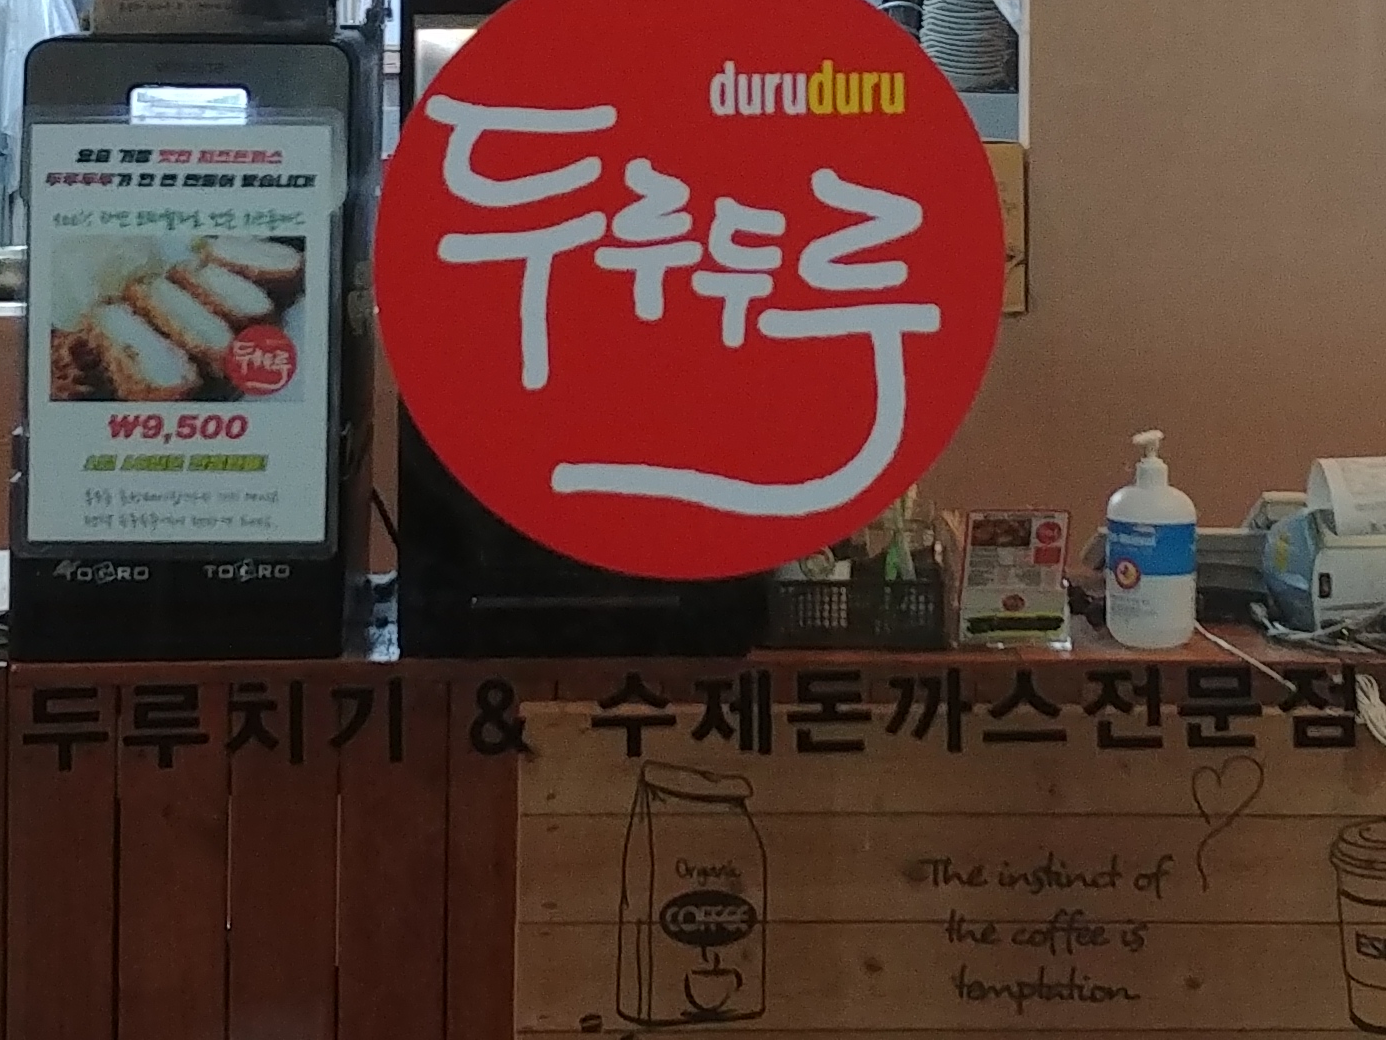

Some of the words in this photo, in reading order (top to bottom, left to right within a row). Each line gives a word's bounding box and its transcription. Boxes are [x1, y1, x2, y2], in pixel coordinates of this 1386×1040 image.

[710, 60, 906, 116] duruduru
[425, 93, 942, 518] 두루두루
[107, 413, 249, 445] ₩9,500
[24, 681, 407, 771] 두루치기
[470, 680, 538, 755] &
[591, 663, 1362, 758] 수제돈까스전문점
[921, 857, 988, 889] The
[999, 853, 1122, 894] instinct
[1133, 853, 1174, 899] of
[945, 913, 1005, 948] the
[1010, 914, 1114, 955] coffee
[1120, 918, 1147, 954] is
